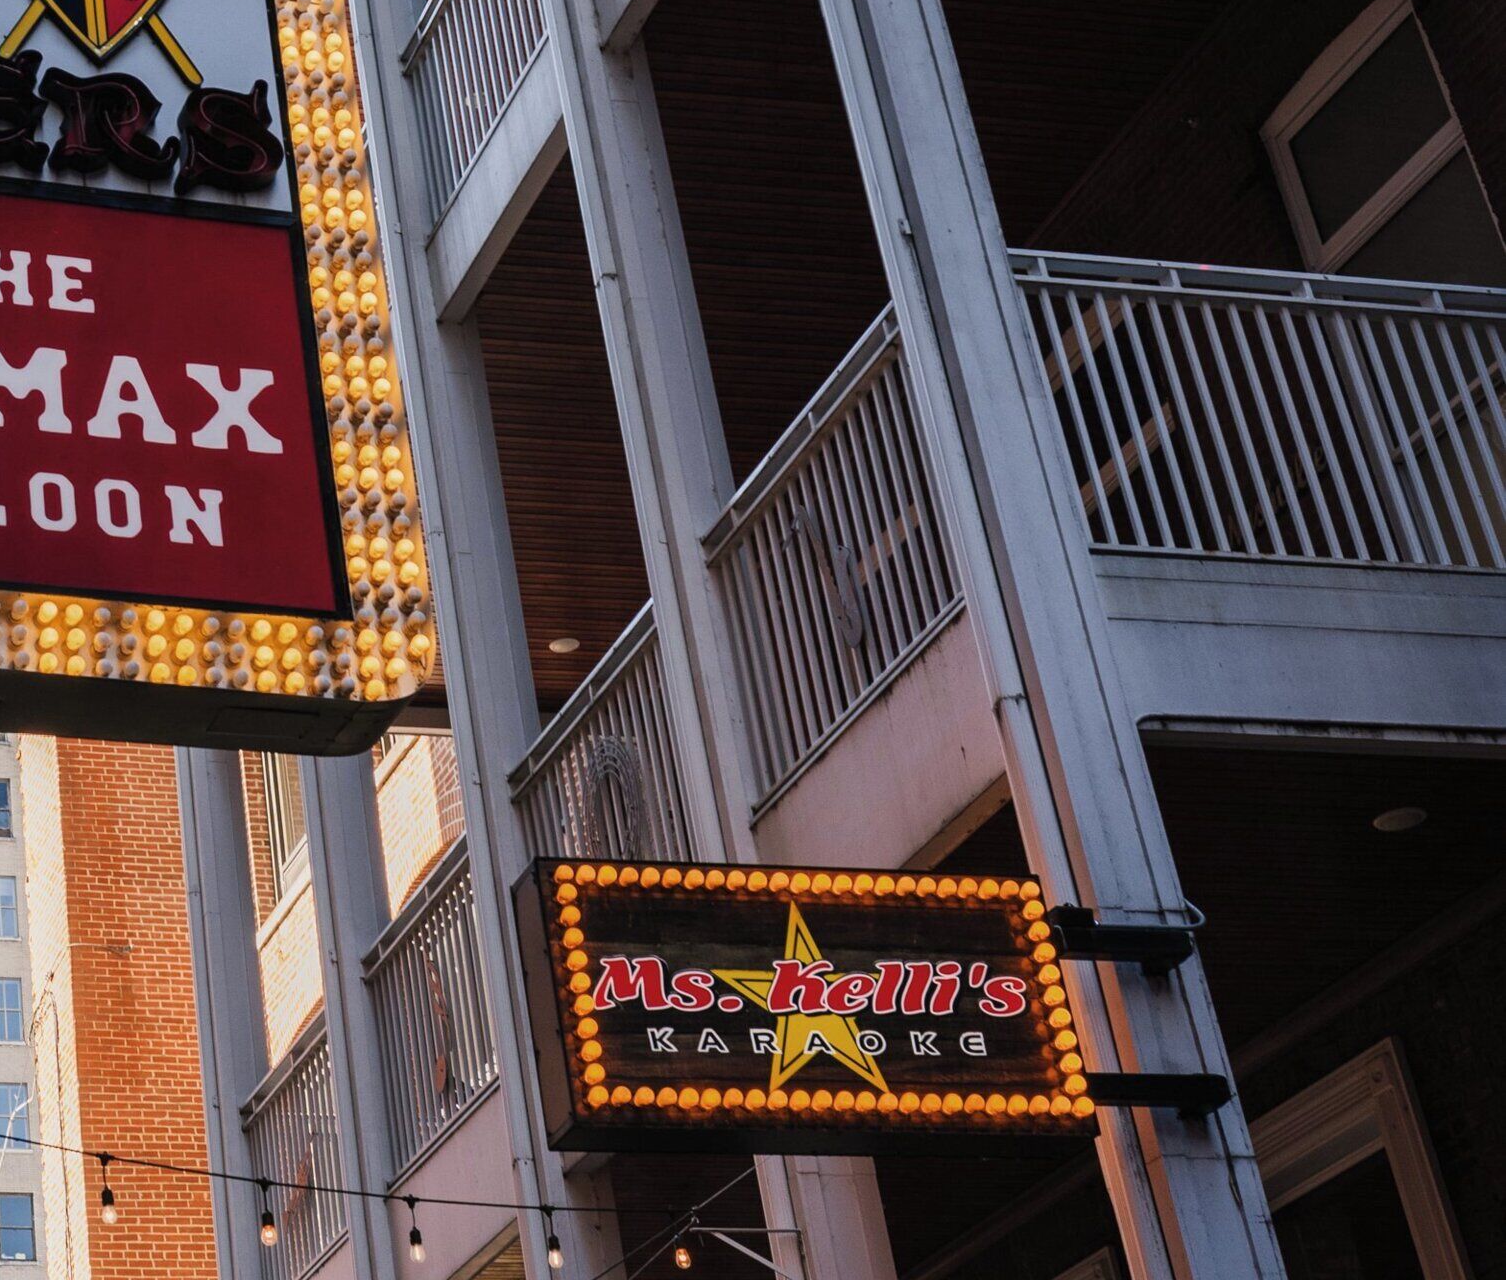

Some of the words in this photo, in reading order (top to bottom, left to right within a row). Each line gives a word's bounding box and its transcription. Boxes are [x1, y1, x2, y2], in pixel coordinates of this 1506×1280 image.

[593, 954, 745, 1013] Ms.
[766, 958, 1029, 1018] Kelli's
[647, 1026, 988, 1058] KARAOKE
